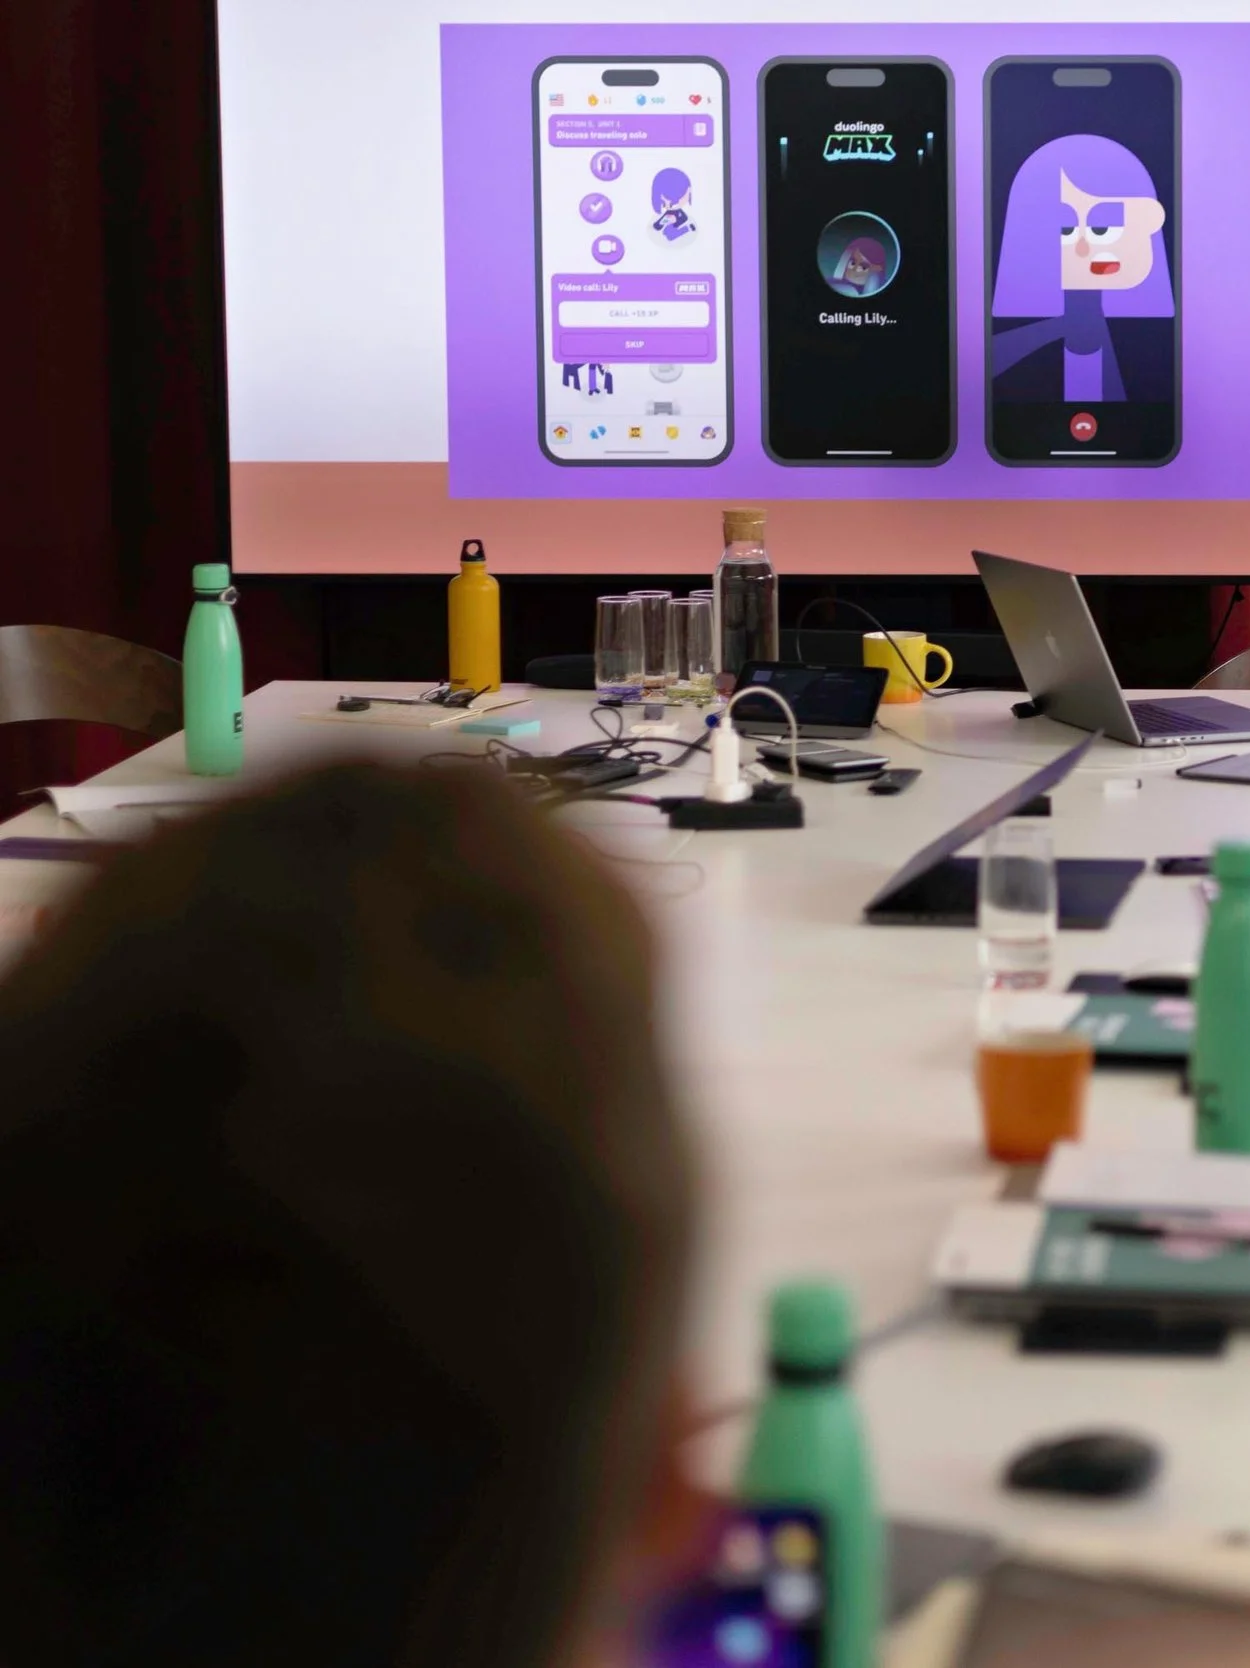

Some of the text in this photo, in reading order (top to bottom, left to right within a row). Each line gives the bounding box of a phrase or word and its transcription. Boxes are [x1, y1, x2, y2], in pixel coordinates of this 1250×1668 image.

[834, 121, 885, 134] duolingo
[556, 131, 648, 141] Discuss traveling solo
[823, 134, 896, 161] MAX
[558, 283, 619, 293] Video call: Lily
[609, 310, 629, 318] CALL
[648, 310, 659, 318] XP
[819, 312, 897, 326] Calling Lily...
[625, 341, 645, 349] SKIP
